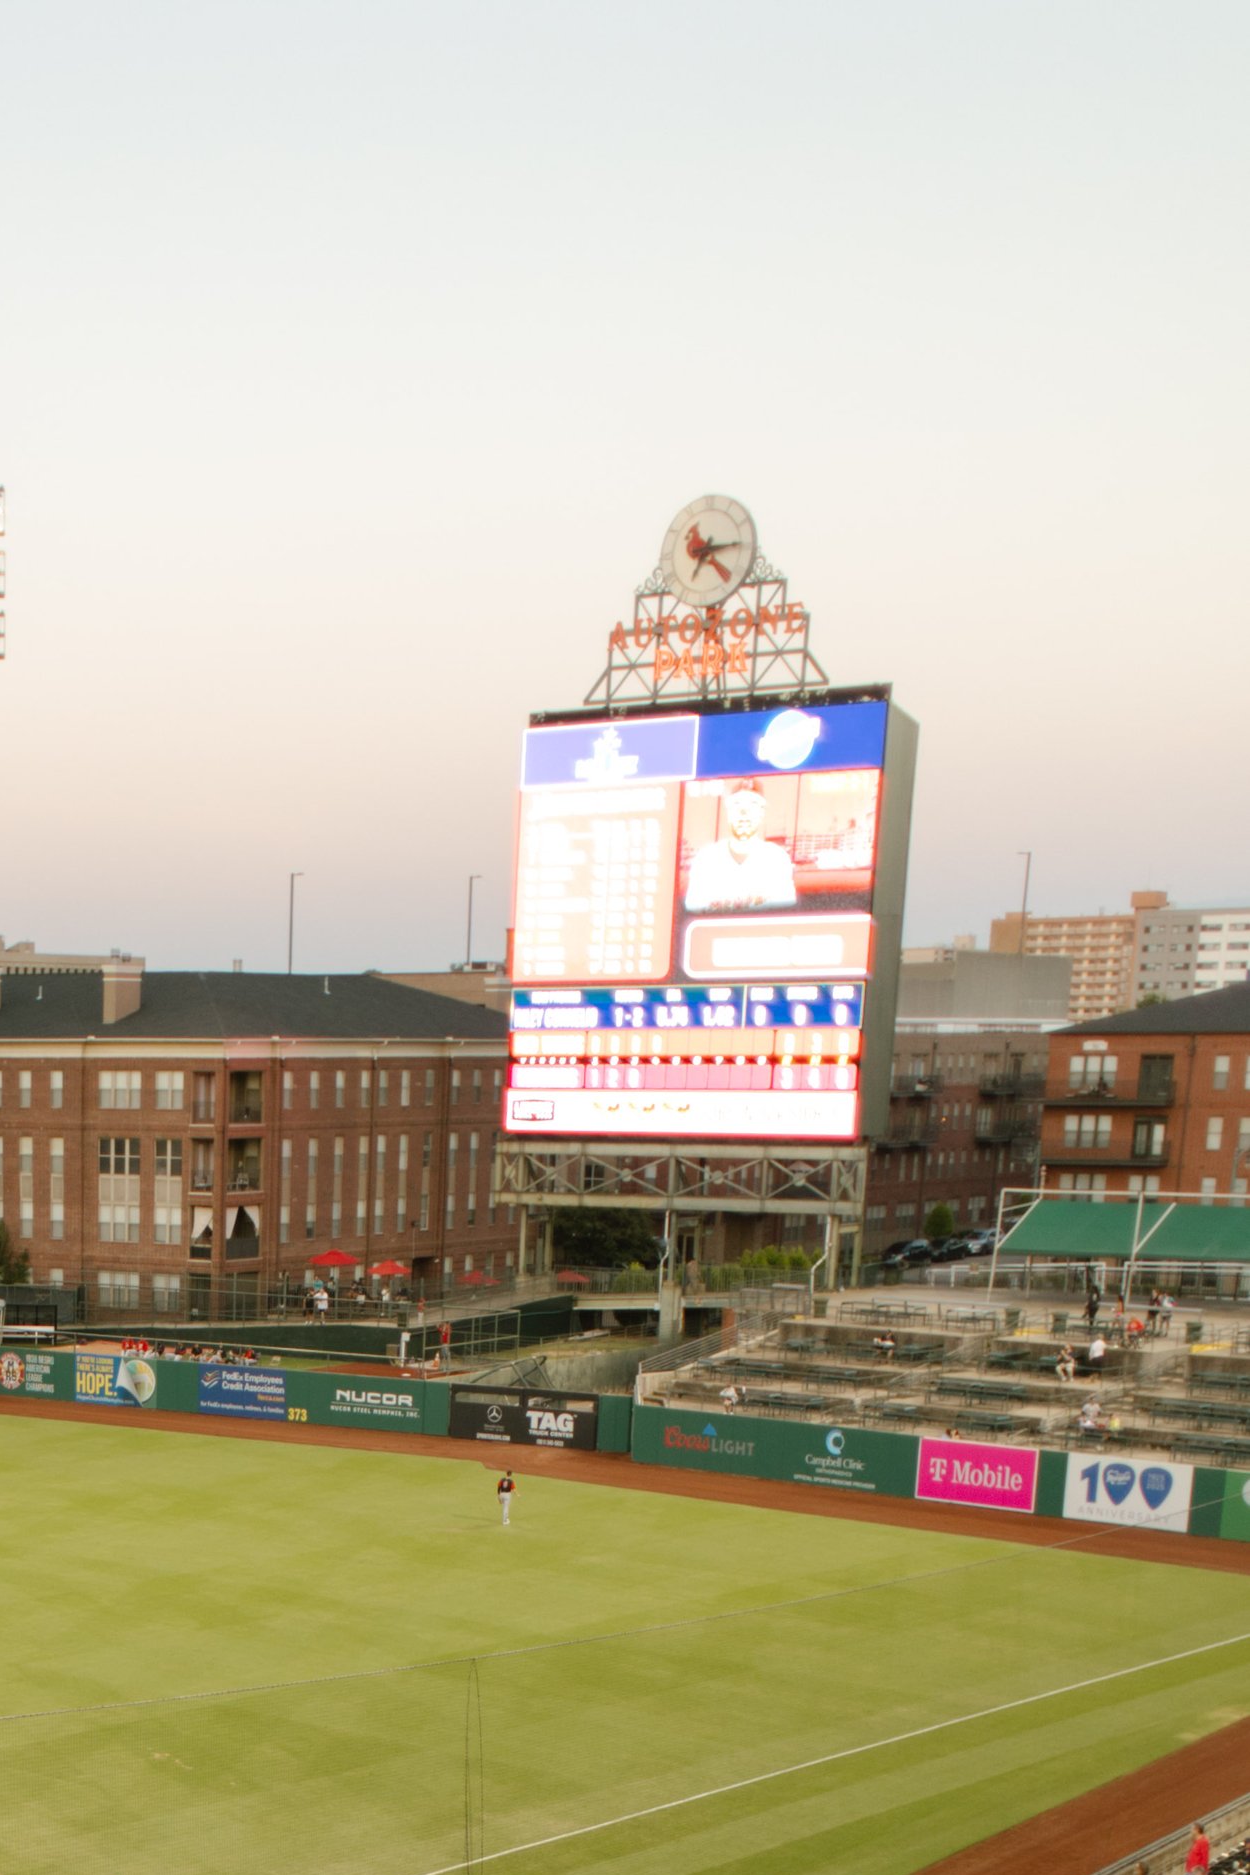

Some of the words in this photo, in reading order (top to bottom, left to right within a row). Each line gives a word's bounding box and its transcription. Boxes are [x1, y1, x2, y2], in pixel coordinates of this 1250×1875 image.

[608, 602, 807, 650] AUTOZONE
[654, 642, 748, 680] PARK
[25, 1373, 43, 1383] LEAGUE
[76, 1371, 118, 1396] HOPE.
[222, 1370, 243, 1380] FedEx
[244, 1373, 283, 1384] Employees
[25, 1383, 54, 1394] CHAMPIONS
[222, 1381, 243, 1390] Credit
[244, 1383, 285, 1394] Association
[335, 1389, 413, 1407] NUCOR
[287, 1407, 308, 1422] 373
[330, 1404, 351, 1413] NUCOR
[352, 1406, 371, 1414] STEEL
[405, 1411, 420, 1419] INC.
[526, 1410, 575, 1433] TAG
[550, 1431, 574, 1439] CENTER
[663, 1425, 710, 1450] Coors
[711, 1439, 755, 1456] LIGHT
[805, 1454, 842, 1468] Campbell
[843, 1457, 866, 1471] Clinic
[951, 1459, 1023, 1492] Mobile
[1080, 1460, 1173, 1511] 100
